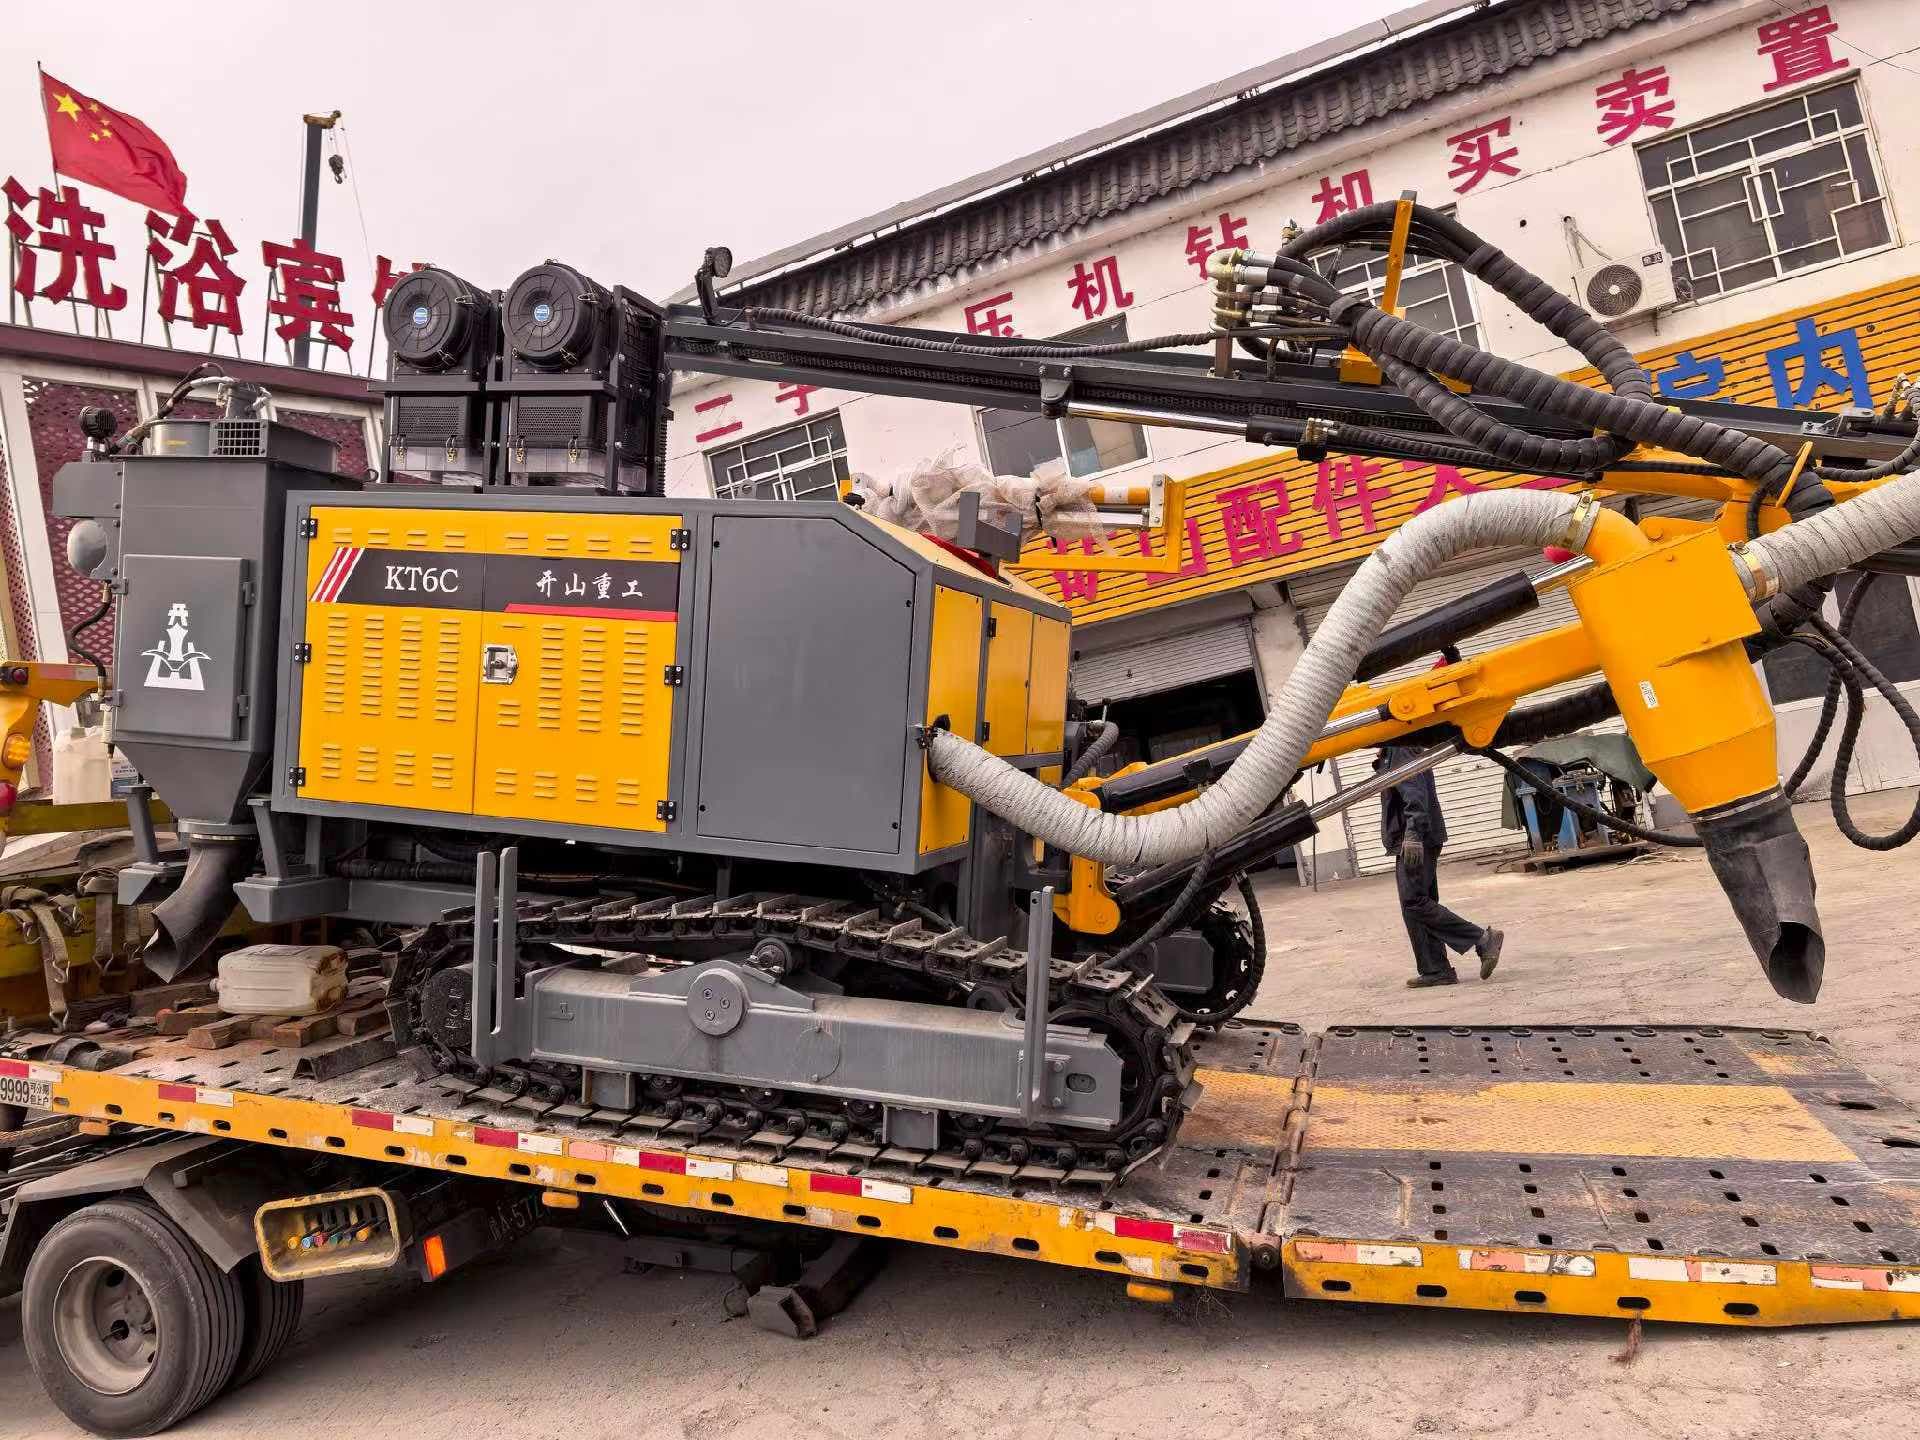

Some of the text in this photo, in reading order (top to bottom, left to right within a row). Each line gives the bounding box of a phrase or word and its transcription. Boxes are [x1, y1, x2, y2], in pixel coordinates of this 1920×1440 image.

[2, 175, 428, 353] 洗浴宾
[384, 565, 459, 593] KT6C
[535, 569, 644, 599] 开山重工
[0, 1077, 29, 1104] 9999
